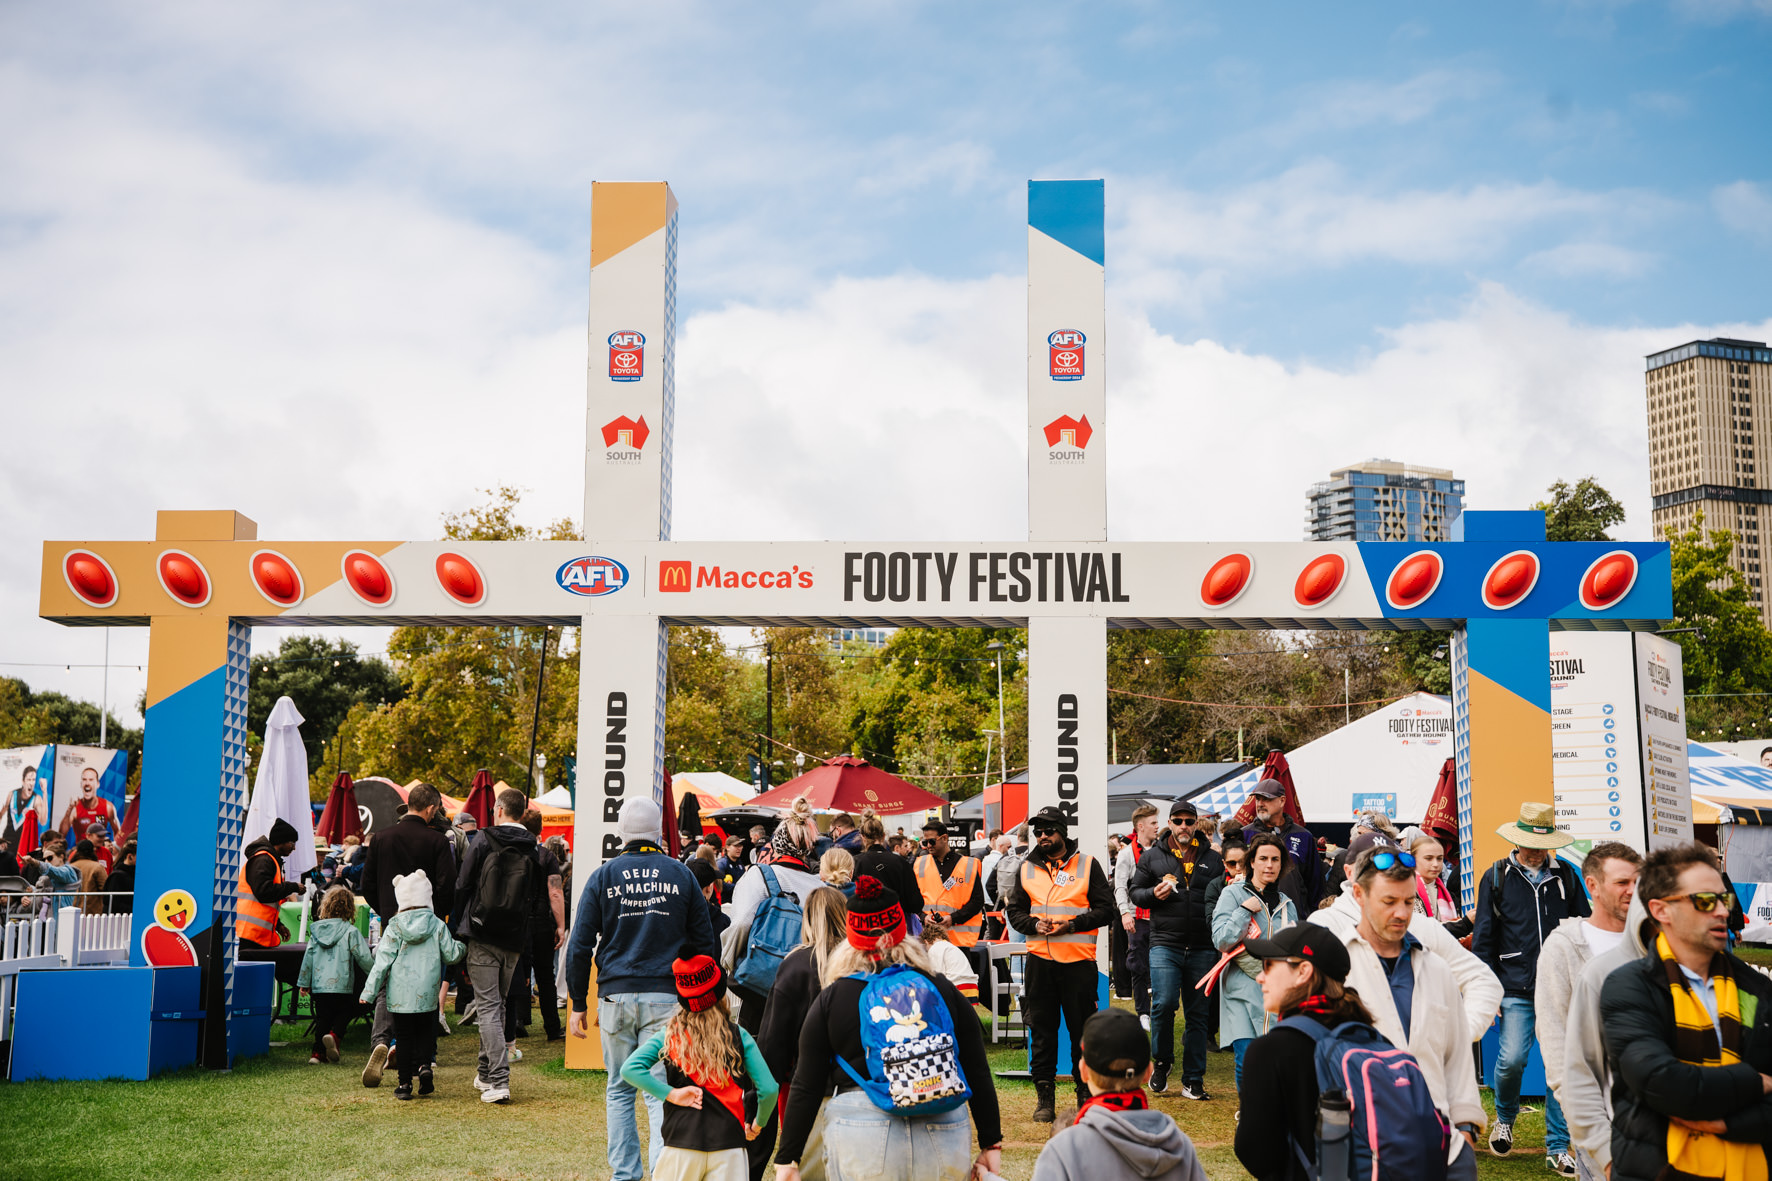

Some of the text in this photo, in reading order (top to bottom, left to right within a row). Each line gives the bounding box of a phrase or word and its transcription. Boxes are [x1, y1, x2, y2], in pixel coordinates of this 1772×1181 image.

[611, 334, 643, 346] AFL
[1051, 333, 1083, 345] AFL
[606, 451, 642, 461] SOUTH
[1049, 451, 1085, 460] SOUTH
[561, 565, 624, 587] AFL
[696, 565, 814, 589] Macca's
[843, 551, 1130, 603] FOOTY FESTIVAL
[1549, 659, 1586, 676] STIVAL
[1389, 718, 1453, 733] FOOTY FESTIVAL
[603, 691, 628, 822] ROUND
[1057, 693, 1079, 826] ROUND
[878, 800, 905, 809] BURGE
[622, 868, 660, 880] DEUS
[1056, 874, 1067, 885] 69
[606, 881, 680, 899] EX MACHINA
[849, 904, 902, 929] BOMBERS
[1757, 906, 1772, 917] FOO
[676, 961, 717, 987] SSENDON
[913, 1075, 942, 1089] SONIC
